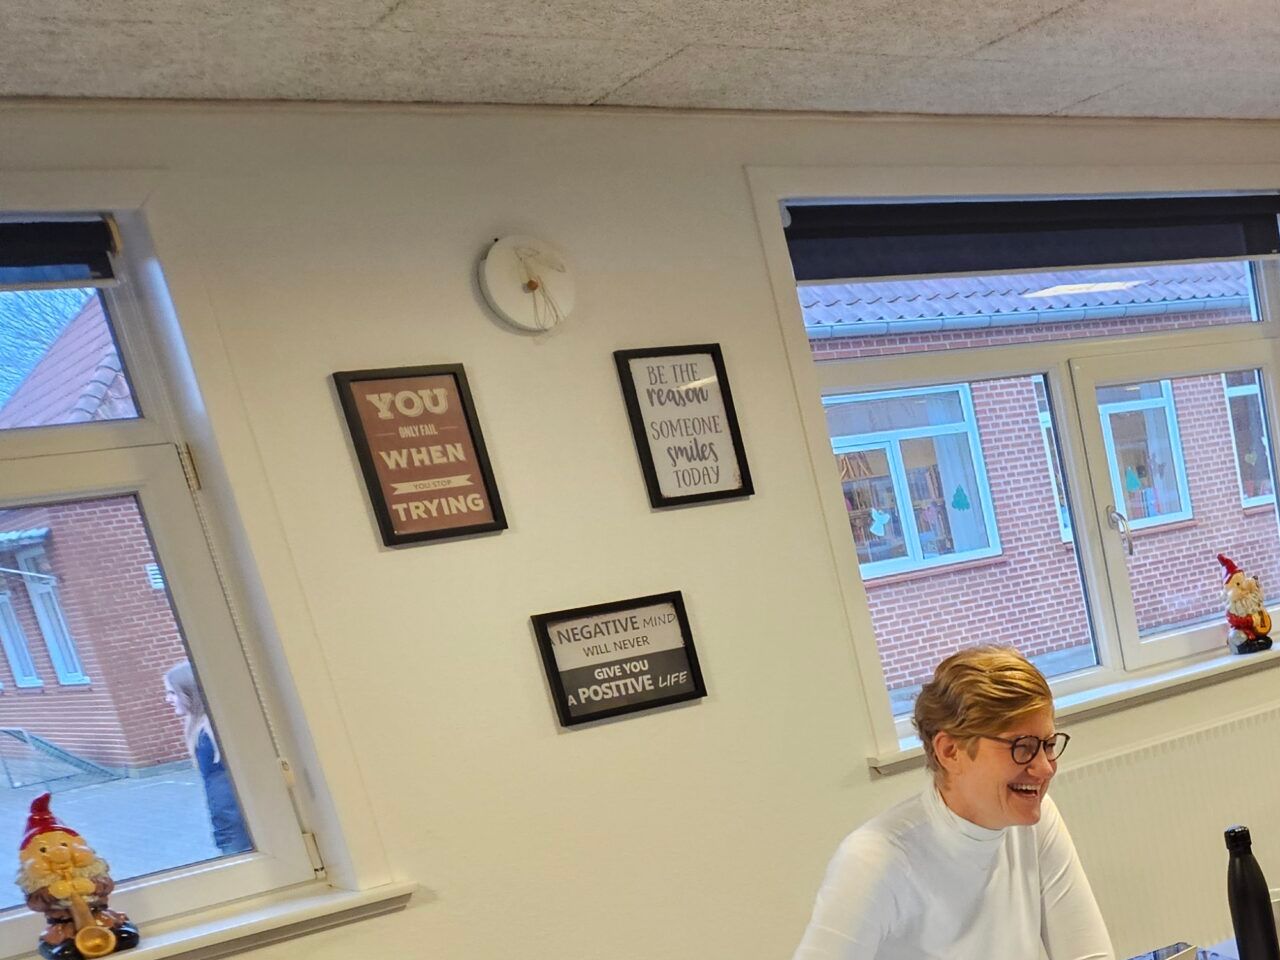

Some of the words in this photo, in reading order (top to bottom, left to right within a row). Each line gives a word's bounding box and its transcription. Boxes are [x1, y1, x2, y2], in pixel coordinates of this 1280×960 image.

[647, 365, 668, 385] BE
[670, 363, 700, 383] THE
[366, 388, 449, 420] YOU
[646, 386, 708, 407] reason
[399, 425, 419, 438] ONLY
[420, 424, 438, 437] FAIL
[650, 415, 723, 440] SOMEONE
[379, 443, 466, 470] WHEN
[666, 438, 719, 467] smiles
[413, 481, 433, 490] YOU
[433, 479, 452, 488] STOP
[673, 466, 720, 488] TODAY
[392, 493, 485, 522] TRYING
[557, 615, 640, 645] NEGATIVE
[642, 613, 677, 629] MIND
[582, 643, 611, 657] WILL
[613, 635, 650, 651] NEVER
[594, 665, 623, 680] GIVE
[623, 659, 649, 675] YOU
[567, 695, 577, 706] A
[578, 675, 655, 704] POSITIVE
[658, 671, 688, 688] LIFE
